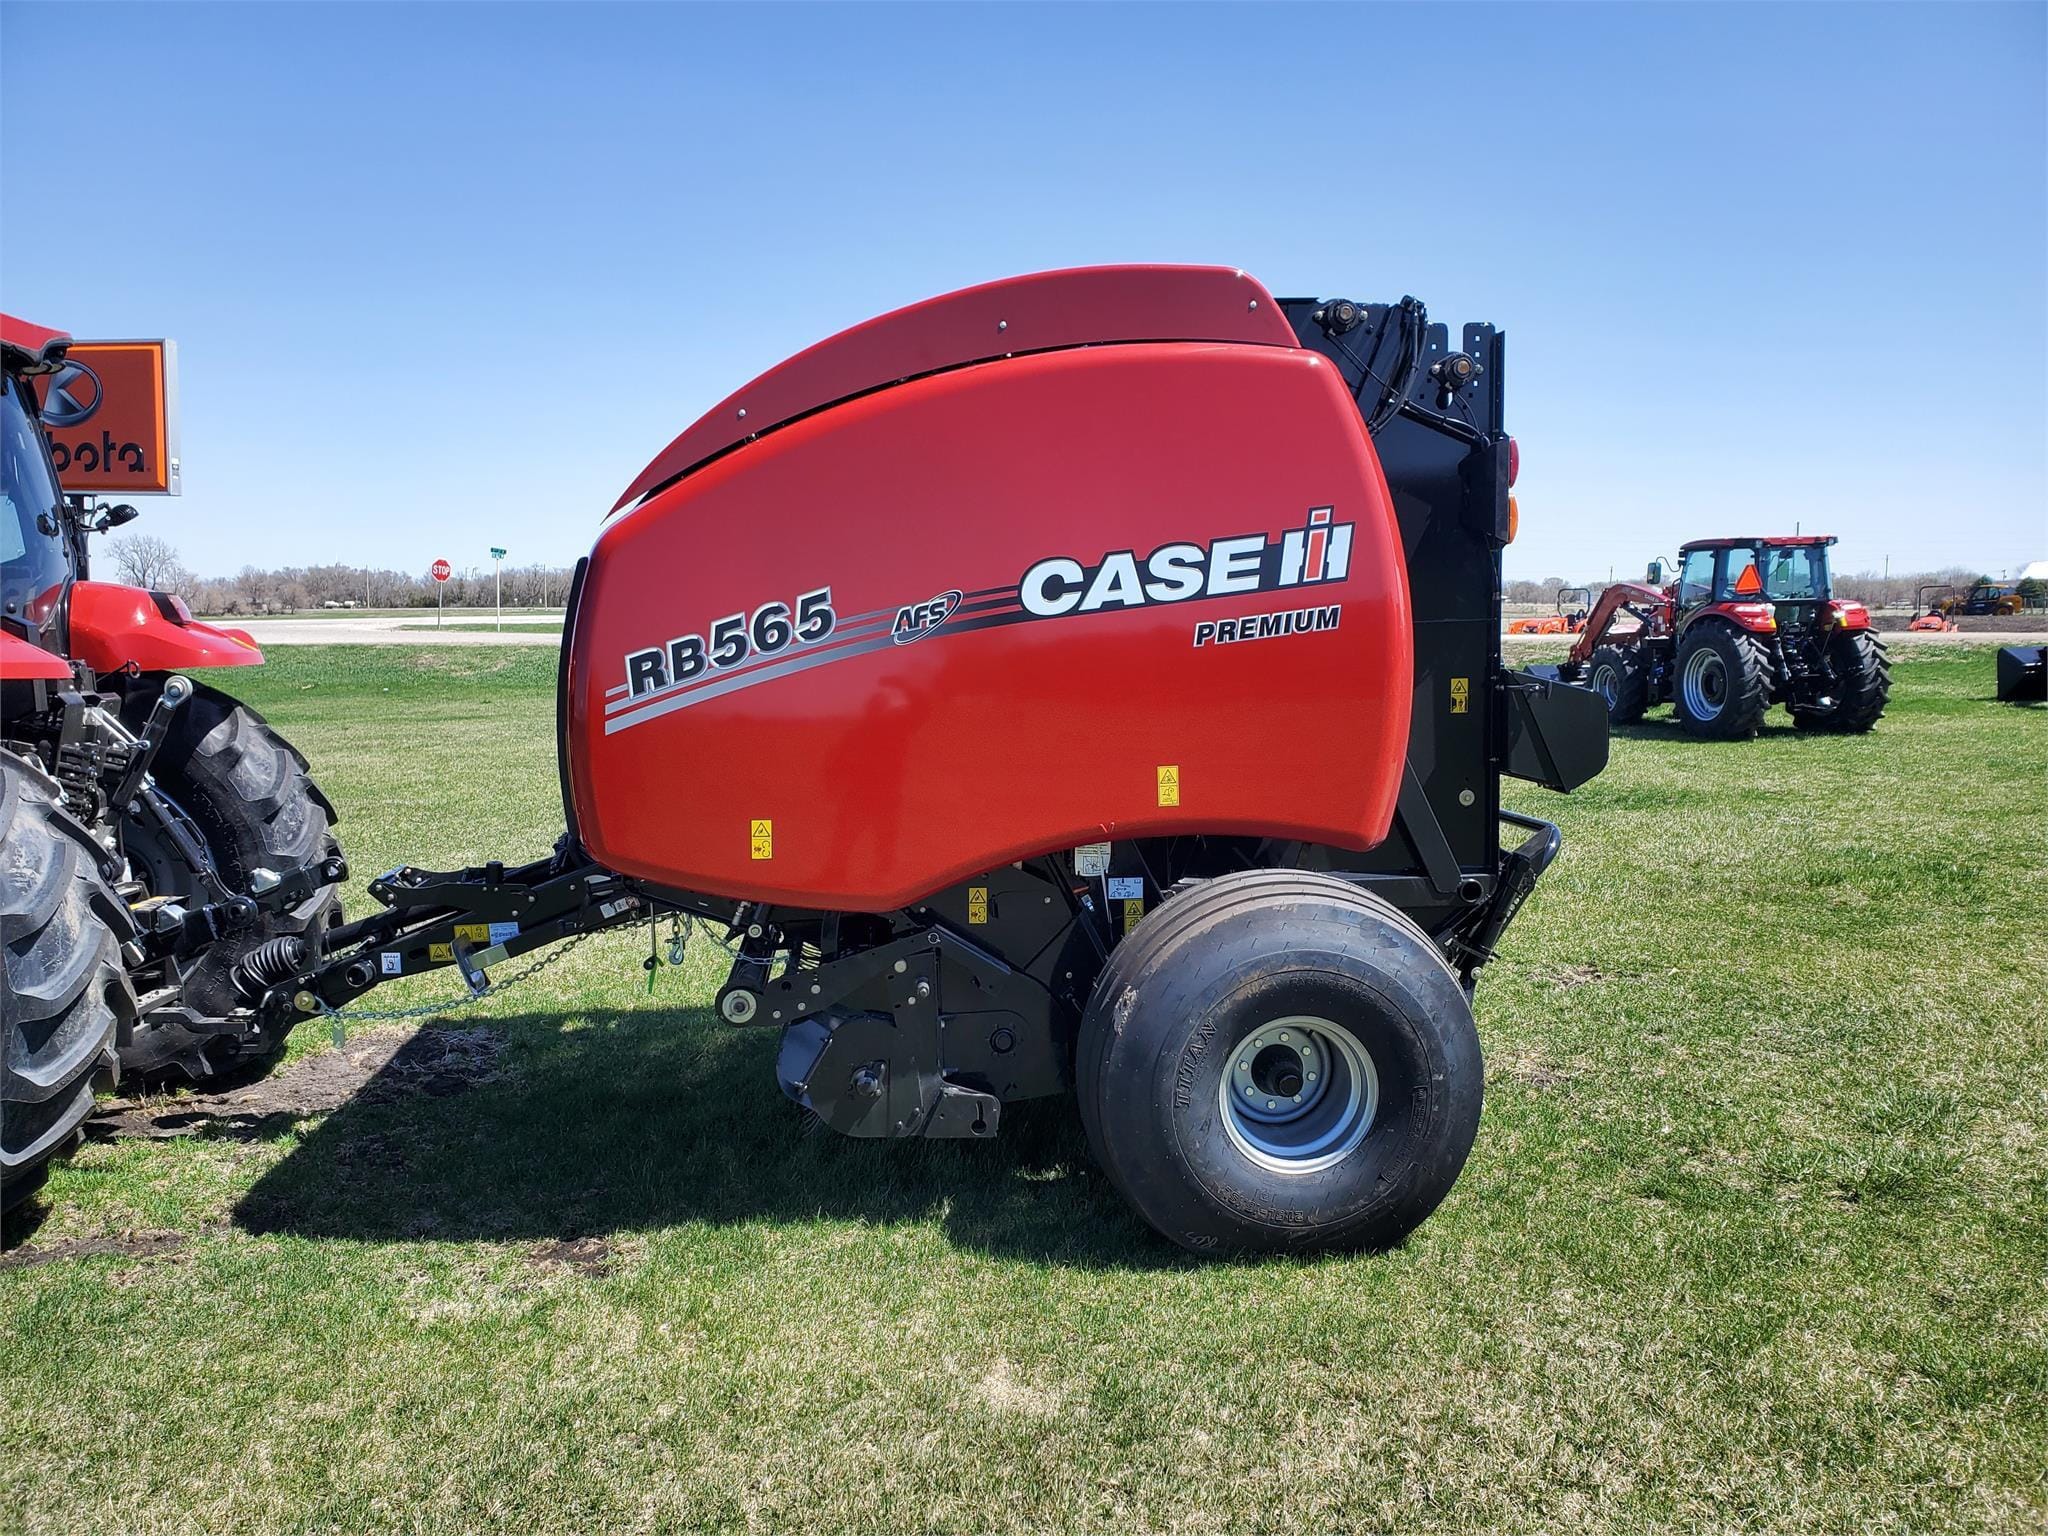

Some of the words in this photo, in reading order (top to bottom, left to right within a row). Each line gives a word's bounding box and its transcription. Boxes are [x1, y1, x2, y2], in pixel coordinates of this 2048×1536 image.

[46, 431, 145, 472] bota
[433, 565, 450, 576] STOP
[1020, 536, 1267, 616] CASE
[891, 597, 948, 635] AFS
[1193, 604, 1342, 647] PREMIUM
[624, 586, 837, 700] RB565
[1175, 1018, 1218, 1108] TITAN
